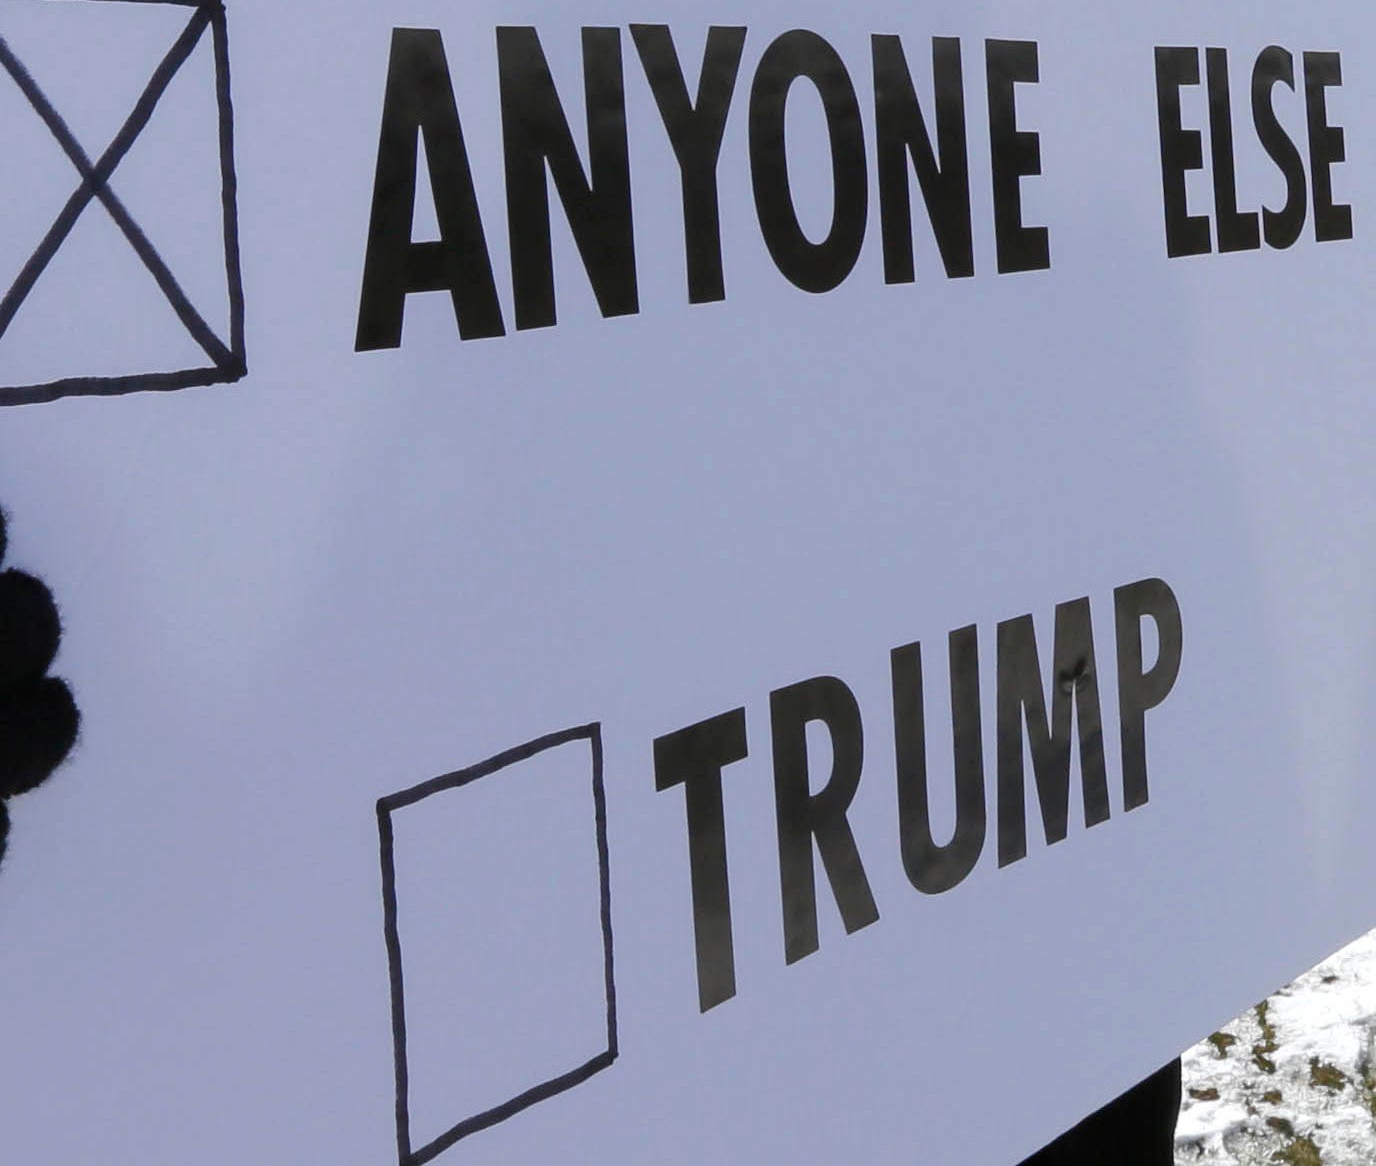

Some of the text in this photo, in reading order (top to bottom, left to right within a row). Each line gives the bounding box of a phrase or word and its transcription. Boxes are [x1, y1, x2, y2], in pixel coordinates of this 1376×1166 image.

[354, 23, 1354, 353] ANYONE ELSE
[652, 577, 1183, 1014] TRUMP
